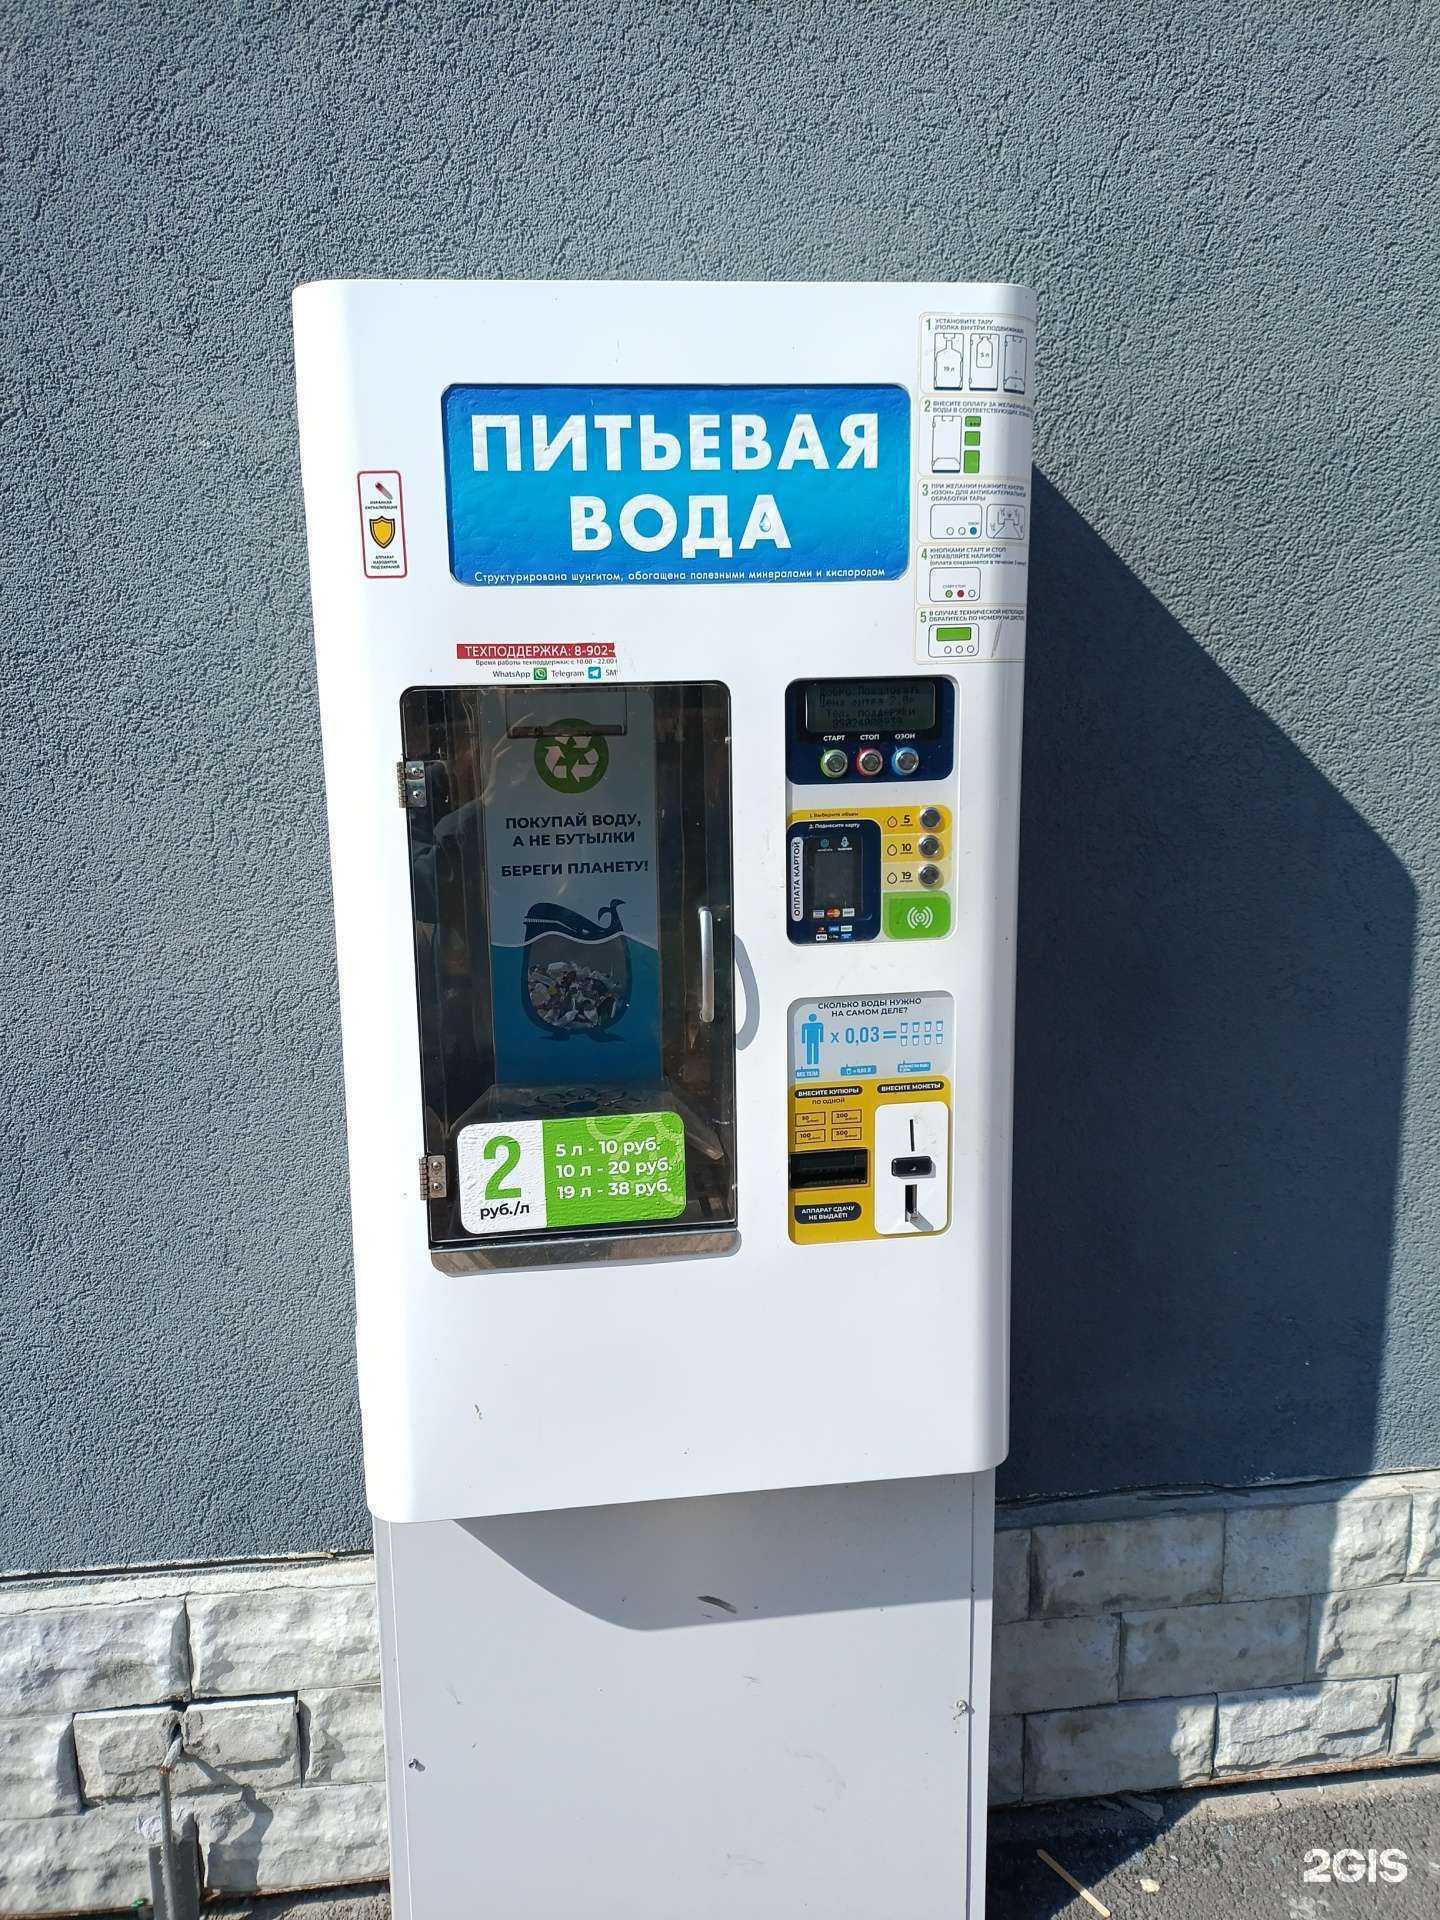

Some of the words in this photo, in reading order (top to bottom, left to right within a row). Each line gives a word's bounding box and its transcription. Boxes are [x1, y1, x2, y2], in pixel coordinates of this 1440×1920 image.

[926, 319, 931, 330] 1
[924, 400, 930, 412] 2
[471, 413, 878, 472] ПИТЬЕВАЯ
[922, 484, 928, 496] 3
[570, 494, 791, 558] ВОДА
[921, 549, 927, 560] 4
[474, 571, 567, 584] Структурирована
[572, 572, 623, 583] шунгитом,
[628, 571, 686, 582] обогащена
[690, 572, 744, 580] полезными
[749, 569, 812, 581] минералами
[826, 569, 885, 579] кислородом
[920, 611, 927, 623] 5
[465, 645, 572, 658] ТЕХПОДДЕРЖКА:
[492, 670, 531, 679] WhatsApp
[551, 669, 584, 677] Telegram
[506, 812, 587, 829] ПОКУПАЙ
[592, 813, 641, 827] ВОДУ,
[903, 815, 910, 823] 5
[512, 835, 524, 847] А
[529, 834, 550, 846] НЕ
[555, 831, 635, 845] БУТЫЛКИ
[902, 843, 912, 851] 10
[501, 863, 562, 877] БЕРЕГИ
[567, 860, 648, 874] ПЛАНЕТУ!
[818, 1001, 859, 1009] СКОЛЬКО
[861, 999, 888, 1008] ВОДЫ
[846, 1009, 880, 1017] САМОМ
[881, 1007, 908, 1016] ДЕЛЕ?
[798, 1089, 828, 1097] ВНЕСИТЕ
[881, 1084, 911, 1092] ВНЕСИТЕ
[556, 1144, 567, 1157] 5
[571, 1145, 583, 1156] л
[599, 1141, 618, 1154] 10
[623, 1137, 661, 1156] руб.
[483, 1135, 522, 1201] 2
[556, 1165, 575, 1178] 10
[580, 1166, 592, 1177] л
[608, 1161, 630, 1175] 20
[635, 1158, 673, 1177] руб.
[557, 1186, 575, 1200] 19
[580, 1187, 592, 1198] л
[608, 1182, 629, 1196] 38
[635, 1179, 672, 1198] руб.
[480, 1201, 530, 1220] руб./л
